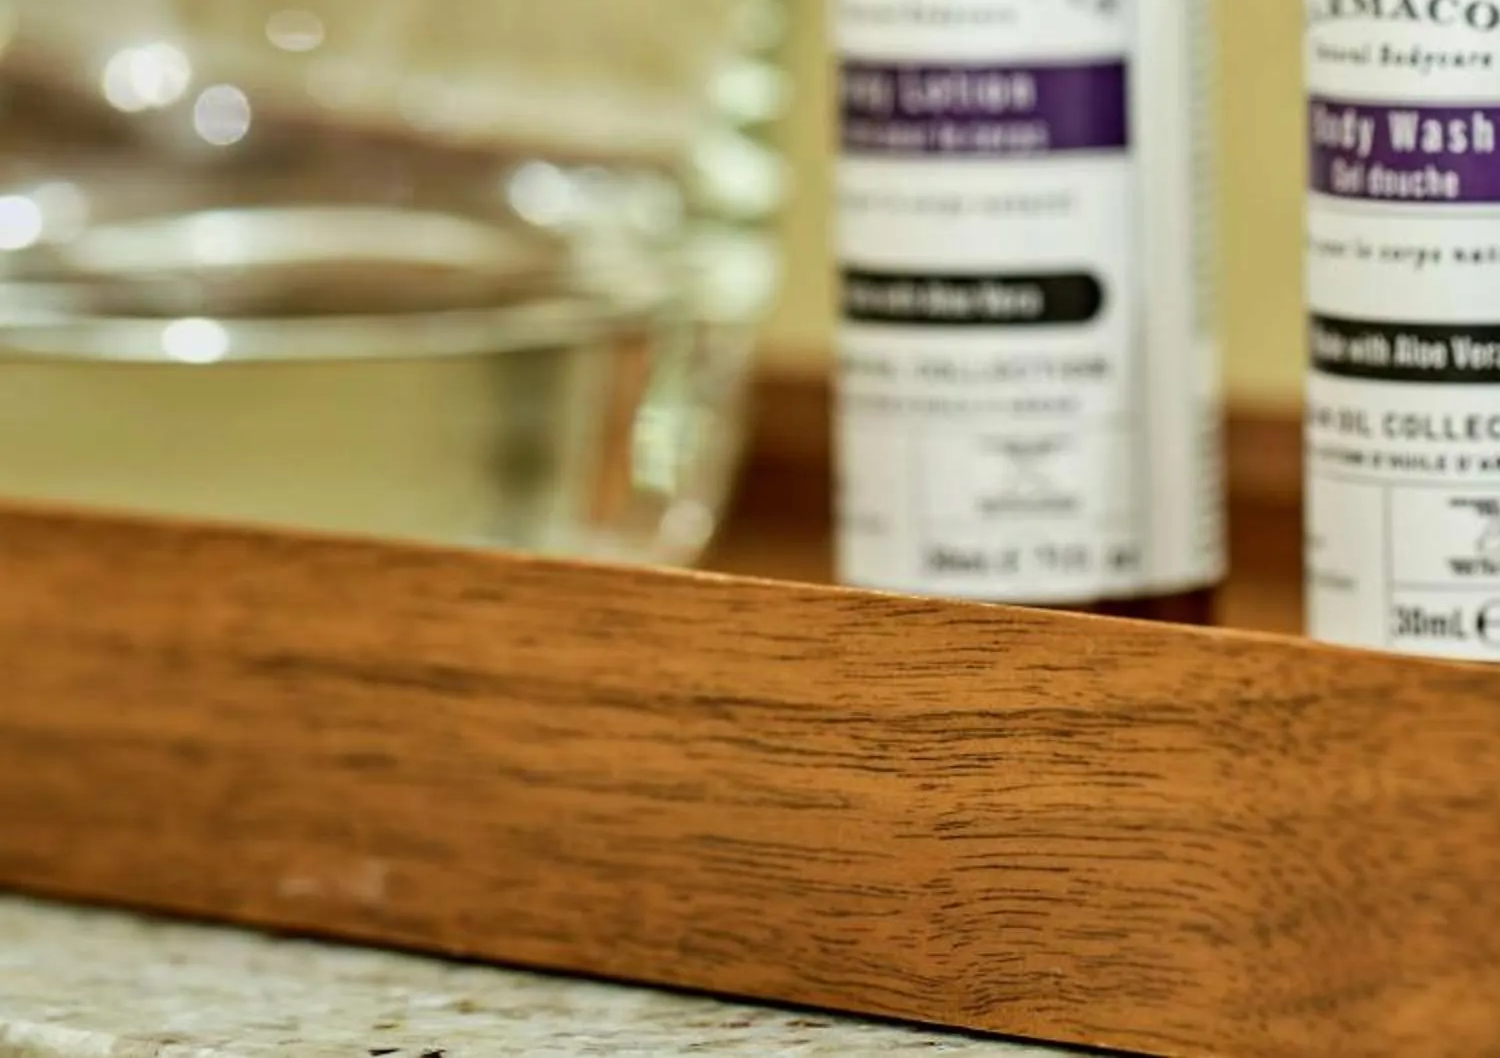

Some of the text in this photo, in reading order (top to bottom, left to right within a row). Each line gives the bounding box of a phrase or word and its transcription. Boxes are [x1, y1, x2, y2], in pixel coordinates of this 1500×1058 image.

[1388, 110, 1496, 155] Wash
[1367, 163, 1460, 199] douche
[1393, 333, 1448, 369] Aloe
